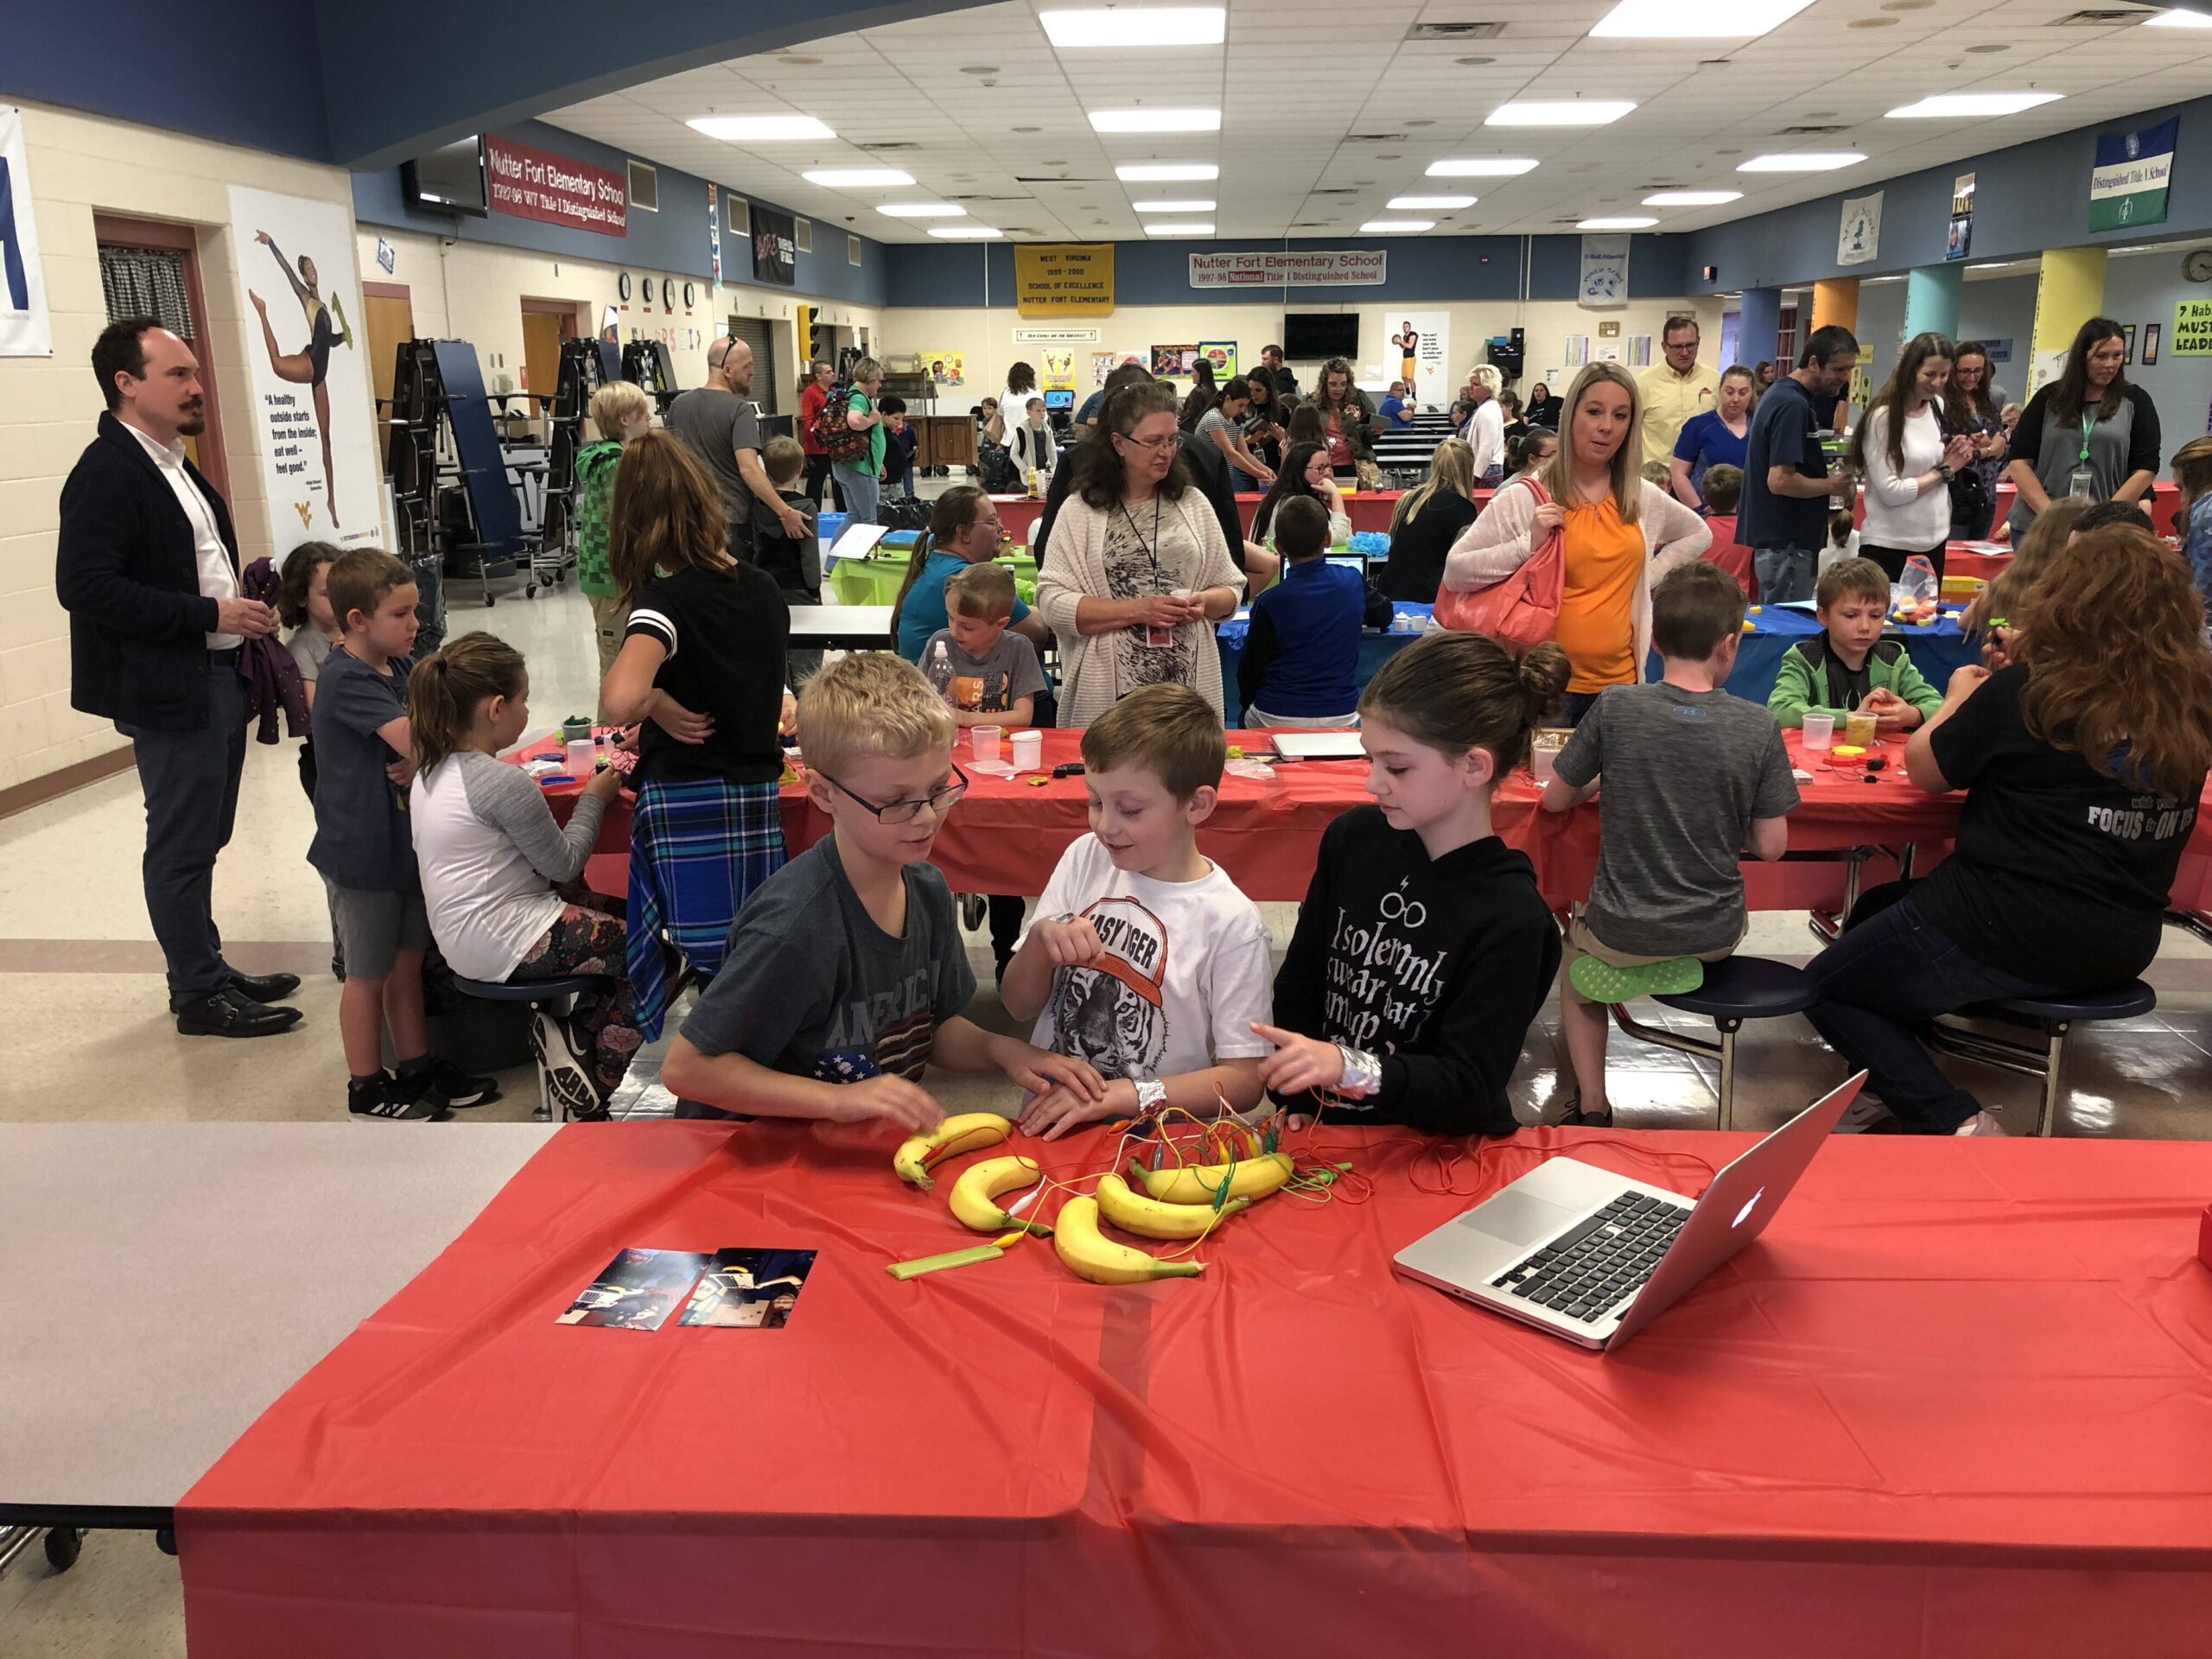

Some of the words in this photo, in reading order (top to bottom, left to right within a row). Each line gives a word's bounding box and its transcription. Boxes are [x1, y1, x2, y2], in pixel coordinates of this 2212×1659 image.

[489, 148, 522, 179] Nutter
[524, 159, 546, 185] Fort
[547, 165, 596, 202] Elementary
[597, 178, 625, 207] School
[2093, 172, 2129, 190] Distinguished
[2131, 170, 2143, 183] Title
[2148, 163, 2168, 180] School
[524, 189, 537, 207] WV
[539, 194, 556, 211] Title
[563, 200, 606, 221] Distinguished
[607, 210, 626, 226] School
[1193, 257, 1231, 269] Nutter
[1236, 257, 1261, 268] Fort
[1265, 256, 1334, 269] Elementary
[1339, 255, 1382, 267] School
[1198, 273, 1227, 283] 1997-98
[1229, 271, 1264, 282] National
[1266, 272, 1284, 282] Title
[1293, 270, 1349, 282] Distinguished
[1351, 270, 1377, 280] School
[2180, 305, 2187, 317] 7
[274, 394, 296, 408] healthy
[270, 411, 292, 423] outside
[293, 410, 309, 422] starts
[272, 429, 287, 440] from
[288, 428, 297, 439] the
[298, 427, 317, 440] inside;
[274, 446, 284, 457] eat
[285, 444, 298, 456] well
[276, 462, 288, 475] feel
[2088, 805, 2144, 840] FOCUS
[2155, 810, 2180, 840] ON
[1090, 914, 1127, 947] ASY
[1331, 906, 1346, 950] I
[1342, 921, 1447, 1006] solemnly
